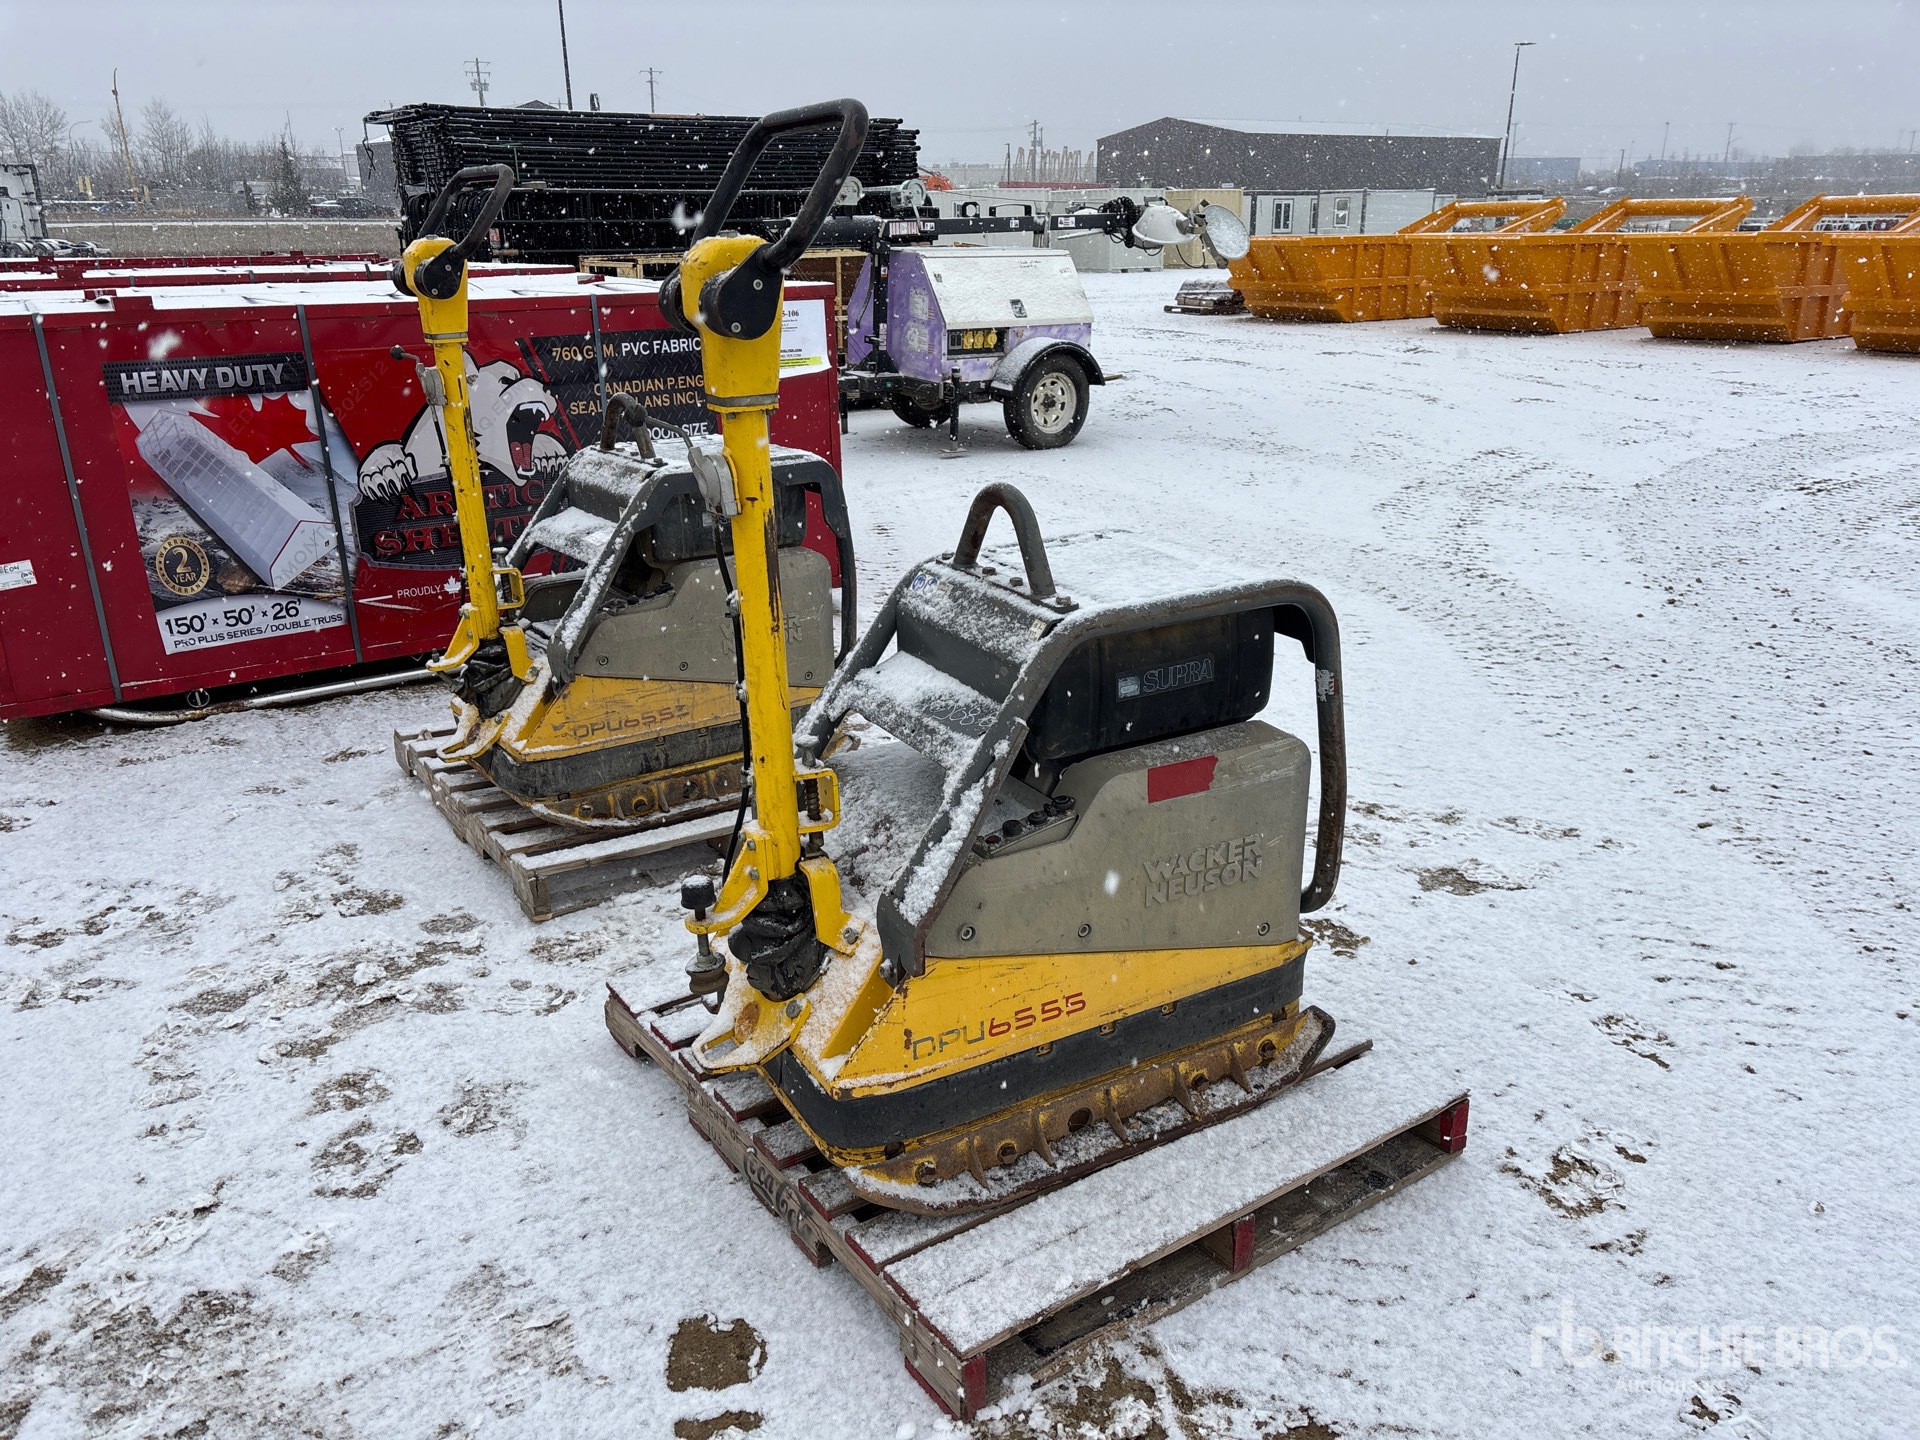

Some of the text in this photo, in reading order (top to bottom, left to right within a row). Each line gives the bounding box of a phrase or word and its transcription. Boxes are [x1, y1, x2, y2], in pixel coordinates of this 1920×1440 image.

[553, 338, 701, 361] 760 GM. PVC FABRIC
[120, 363, 284, 394] HEAVY DUTY
[673, 391, 705, 405] INCL.
[682, 423, 709, 437] SIZE
[396, 480, 546, 520] ARTIC
[159, 539, 204, 558] WARRANTY
[172, 547, 192, 573] 2
[164, 573, 207, 594] WARRANTY
[172, 572, 197, 584] YEAR
[397, 585, 441, 599] PROUDLY
[165, 613, 207, 637] 150'
[223, 605, 256, 627] 50'
[272, 598, 302, 621] 26'
[174, 637, 196, 649] PRO
[198, 632, 226, 645] PLUS
[312, 613, 343, 626] TRUSS
[1143, 659, 1213, 693] SUPRA
[1142, 834, 1263, 883] WACKER
[1145, 858, 1262, 908] NEUSON
[912, 992, 1087, 1060] DPU6555
